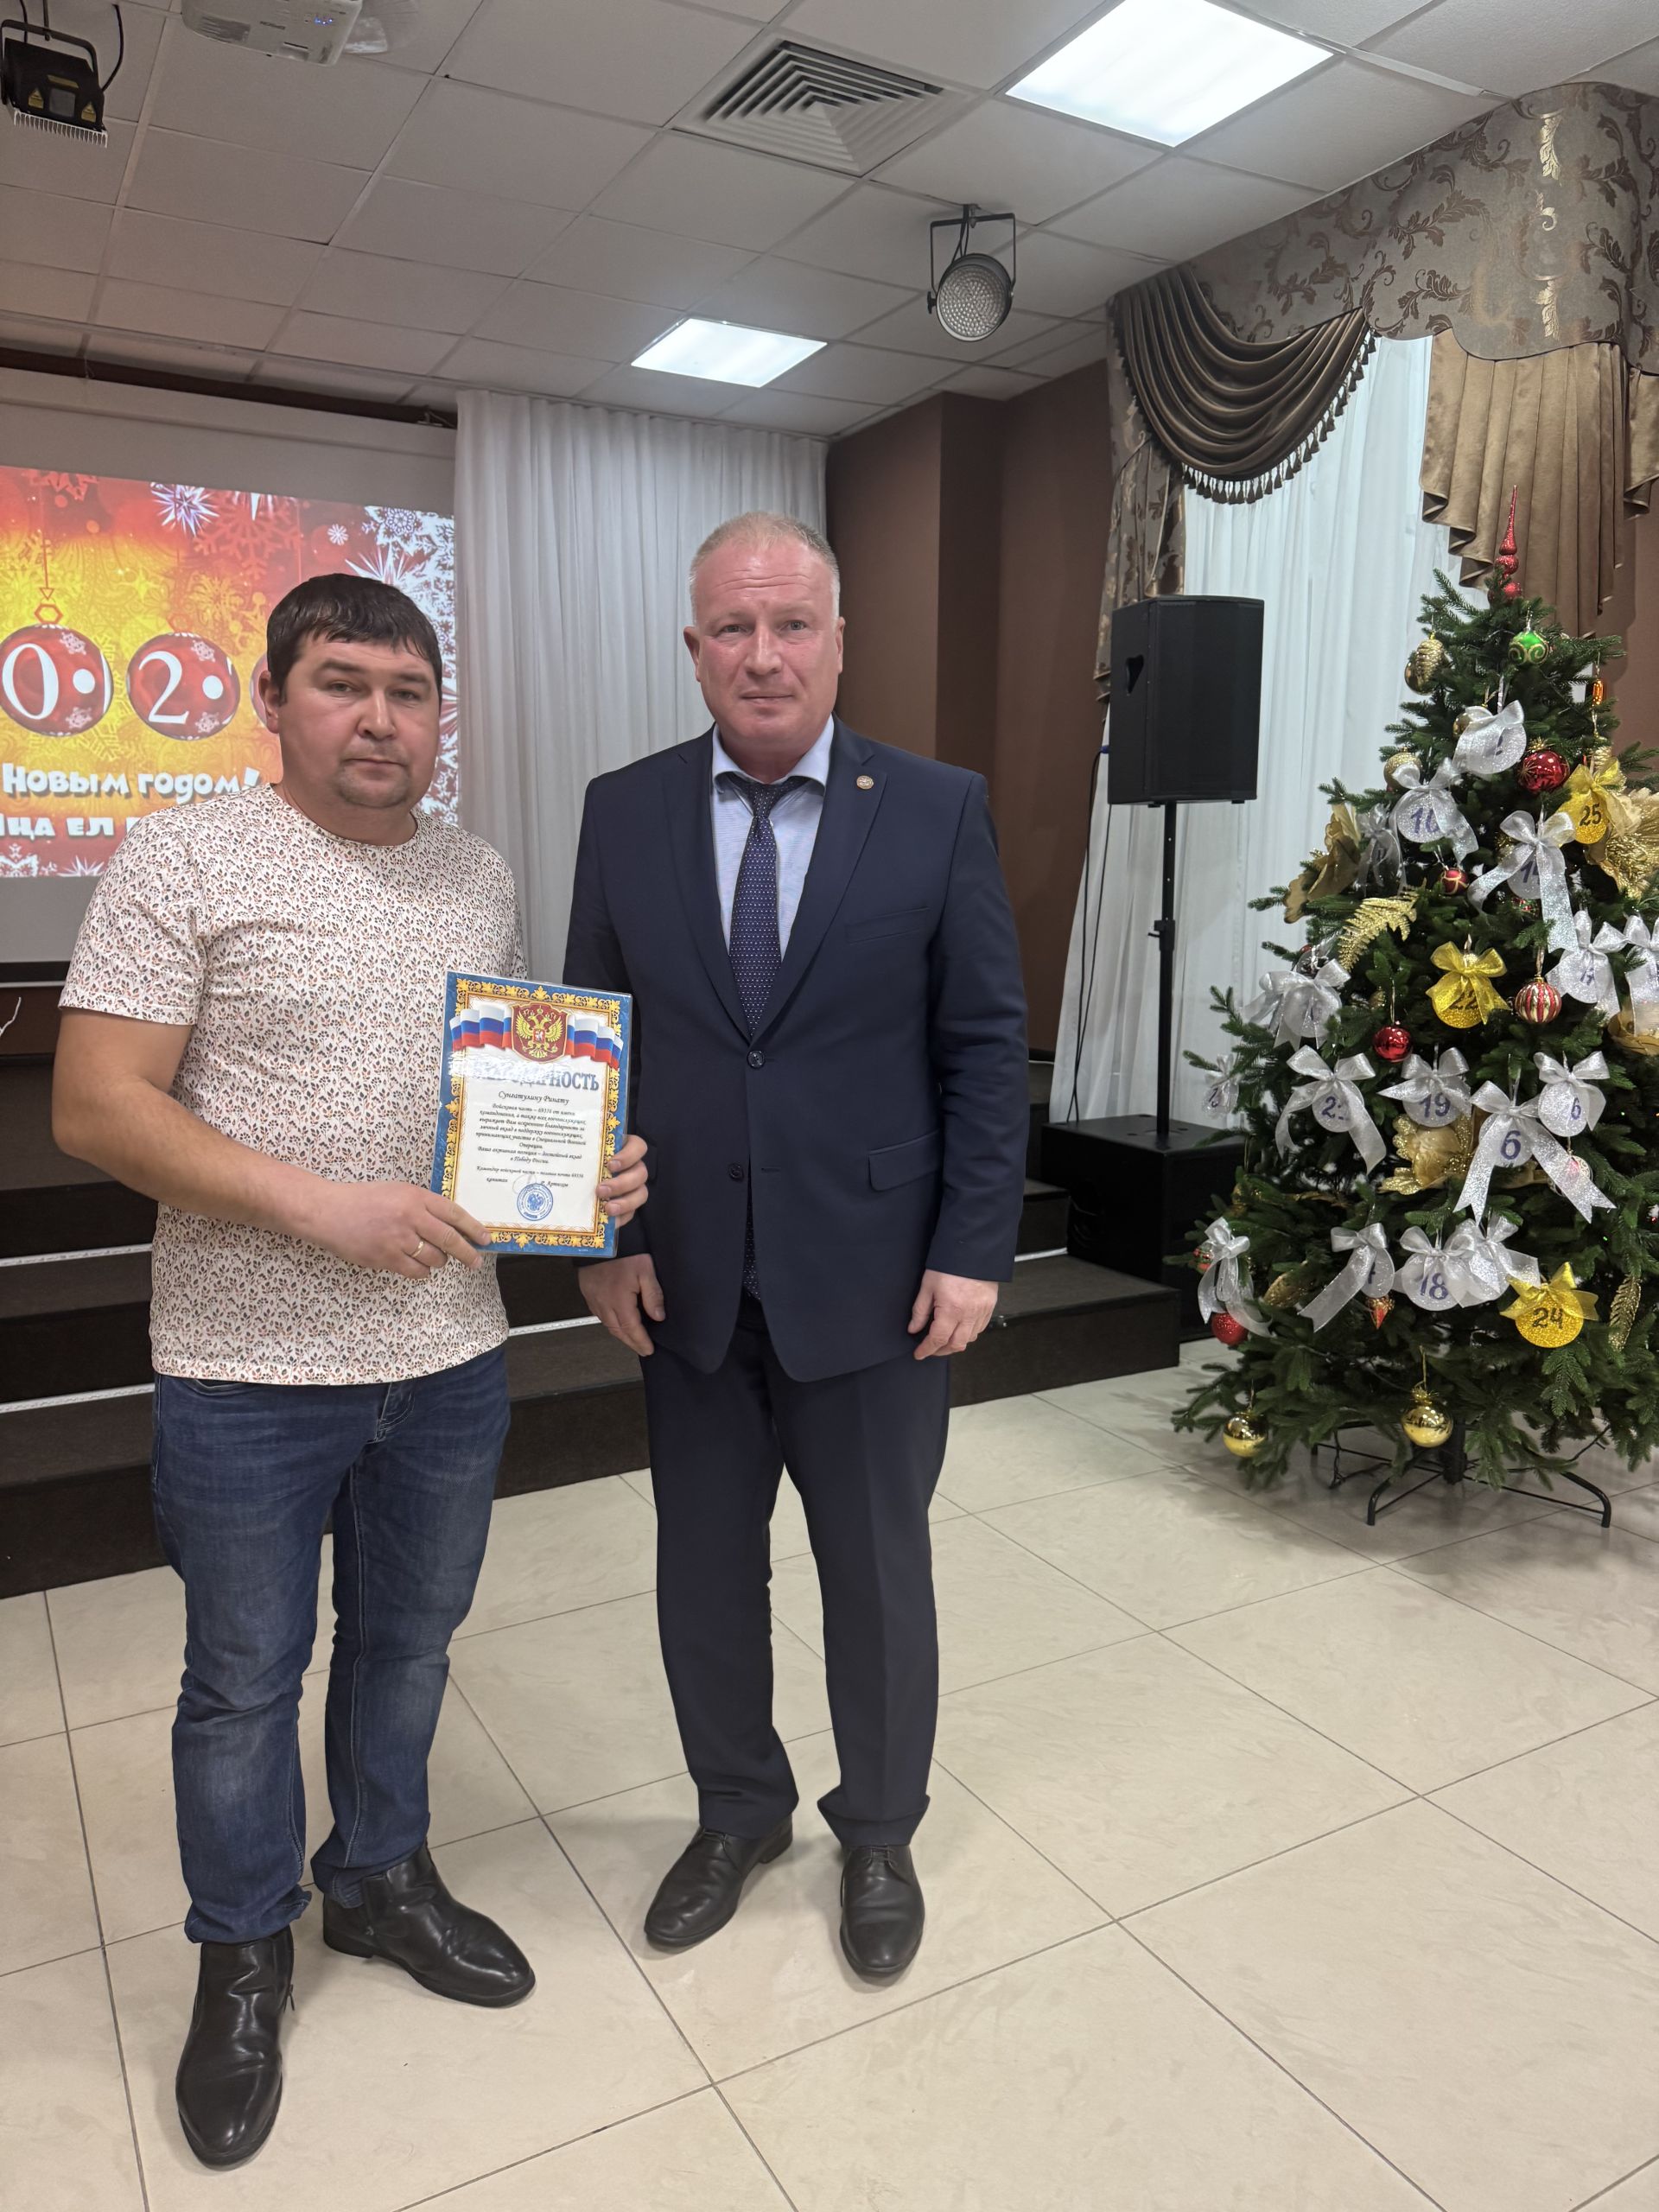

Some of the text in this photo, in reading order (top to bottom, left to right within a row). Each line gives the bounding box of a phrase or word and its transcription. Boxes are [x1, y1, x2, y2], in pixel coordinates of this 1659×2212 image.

[2, 762, 130, 799] Новым
[1579, 803, 1602, 827] 25
[1418, 1092, 1451, 1117] 19
[1500, 1129, 1522, 1160] 6
[1420, 1272, 1449, 1300] 18
[1532, 1306, 1564, 1330] 24
